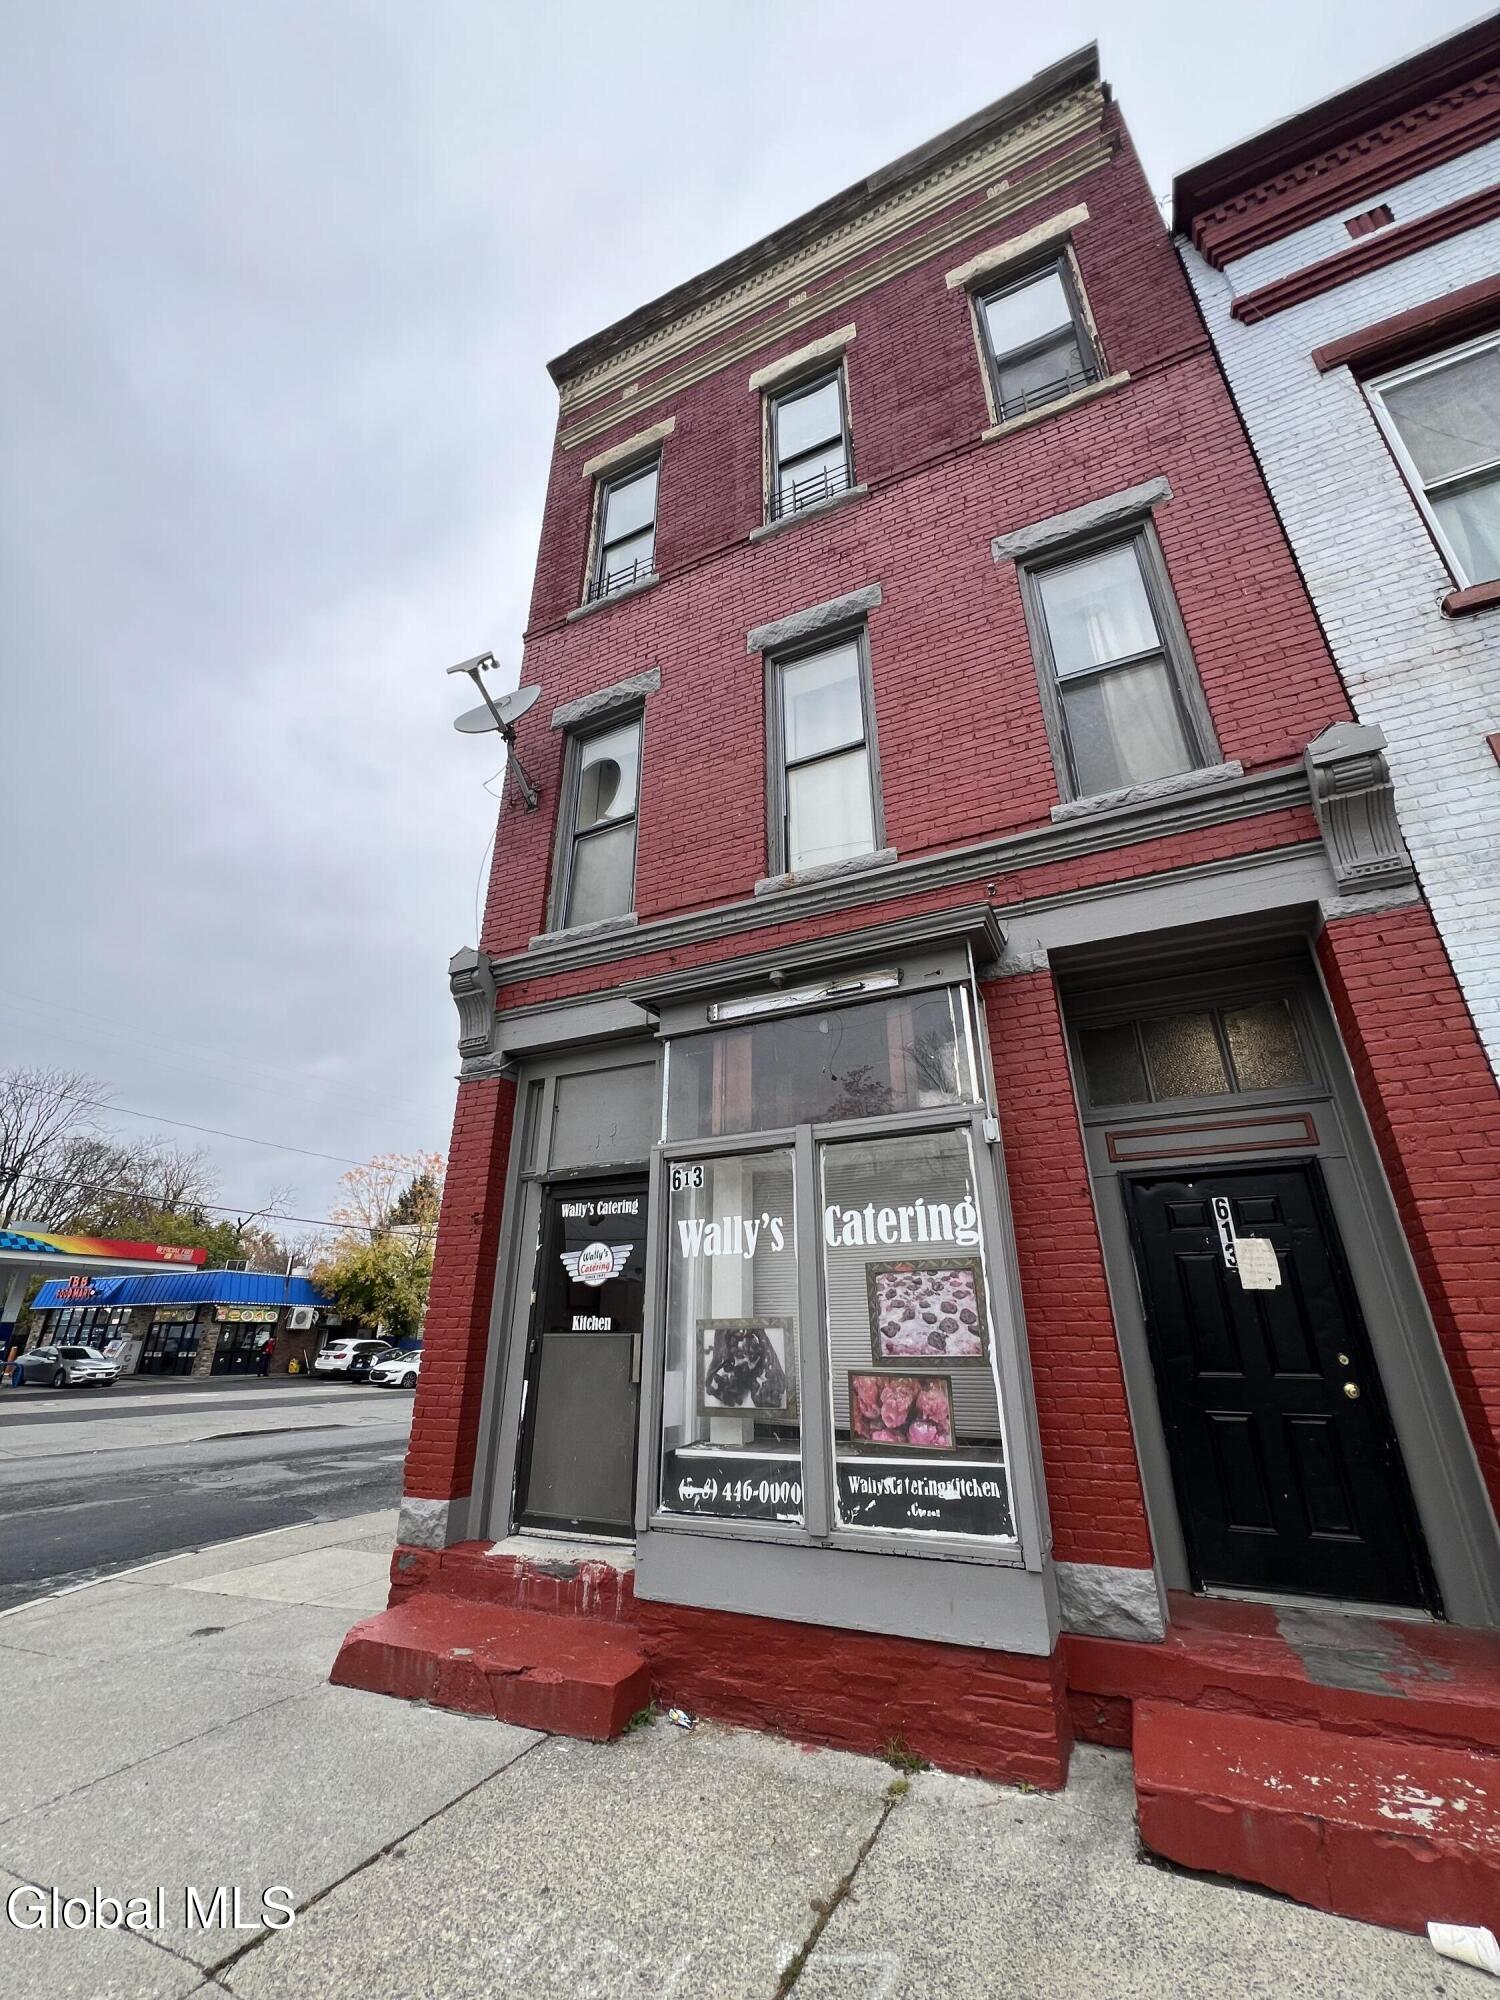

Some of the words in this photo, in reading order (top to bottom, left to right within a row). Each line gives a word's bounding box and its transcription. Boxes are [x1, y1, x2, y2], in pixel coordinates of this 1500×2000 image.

[672, 1167, 703, 1190] 613
[561, 1202, 595, 1218] Wally's
[597, 1198, 639, 1215] Catering
[678, 1212, 785, 1259] Wally's
[824, 1195, 979, 1246] Catering
[1214, 1198, 1237, 1267] 613
[583, 1249, 609, 1262] Wally's
[580, 1262, 610, 1274] Catering
[572, 1315, 611, 1331] Kitchen
[121, 1343, 133, 1373] ICE
[722, 1479, 802, 1505] 446-0000
